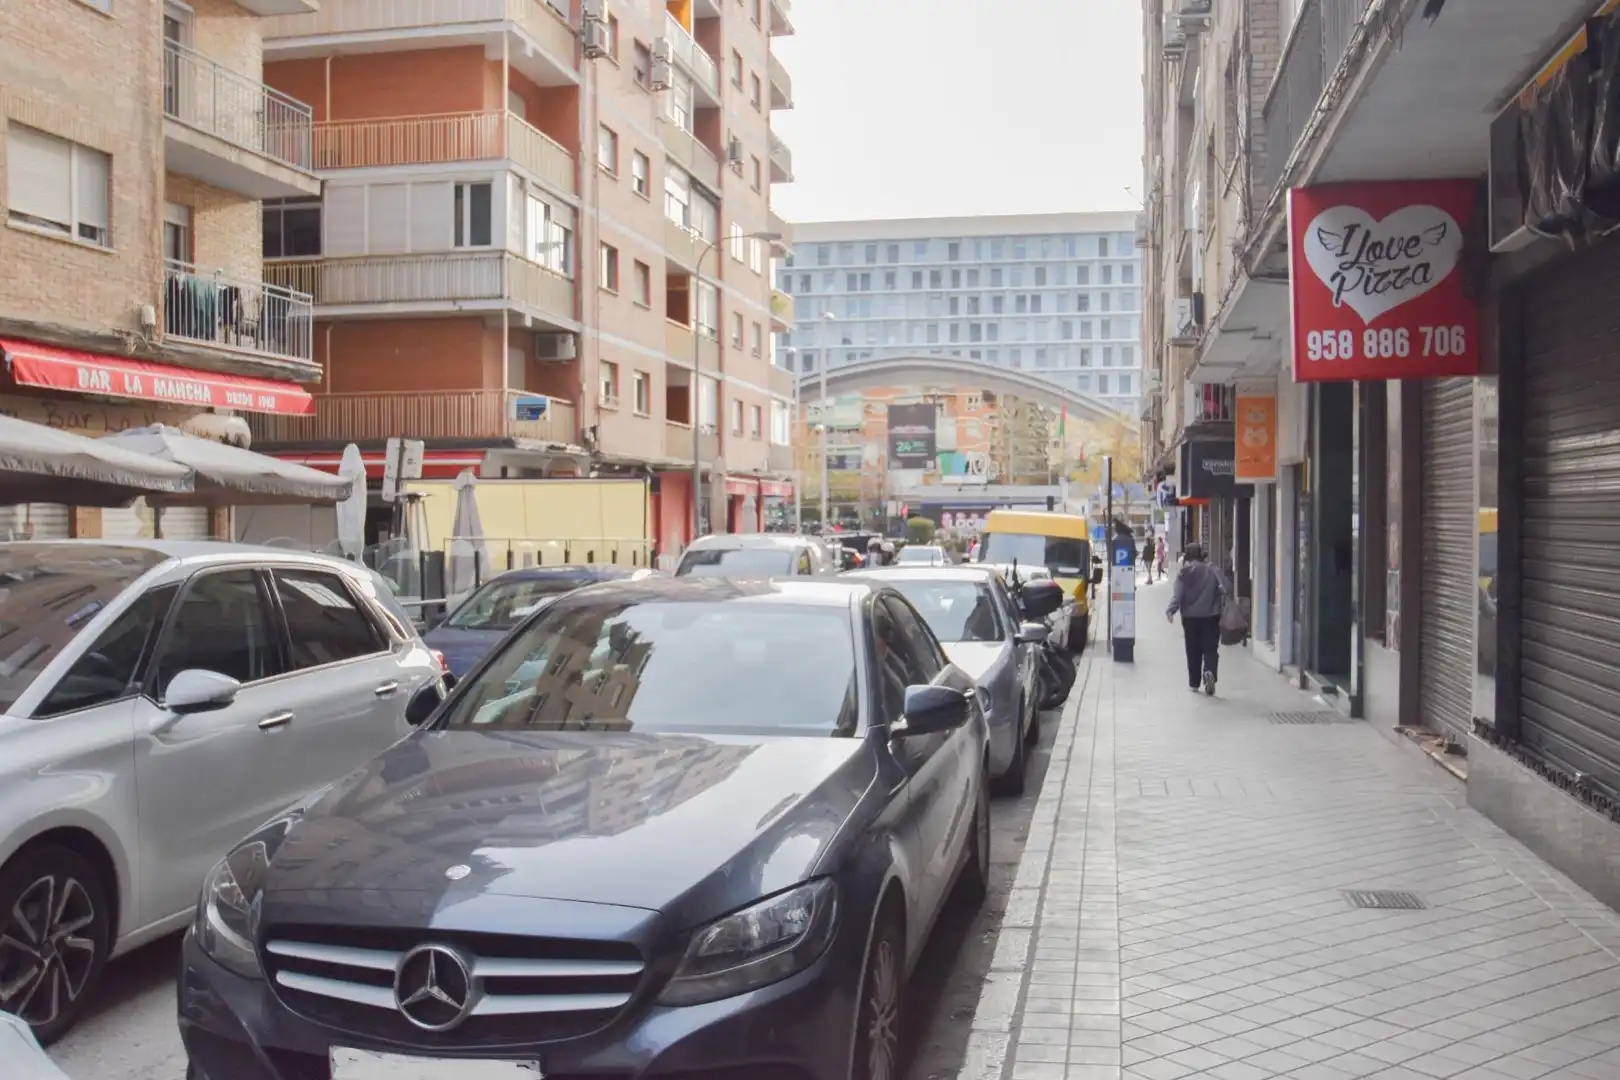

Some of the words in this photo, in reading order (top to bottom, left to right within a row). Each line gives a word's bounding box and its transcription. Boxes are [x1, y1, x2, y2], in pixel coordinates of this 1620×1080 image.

[1338, 229, 1425, 271] Love
[1330, 262, 1434, 305] Pizza
[1307, 330, 1353, 361] 958
[1363, 327, 1409, 359] 886
[1419, 325, 1465, 357] 706
[77, 367, 110, 393] BAR
[124, 372, 143, 394] LA
[153, 378, 212, 403] MANCHA
[1115, 549, 1128, 564] P
